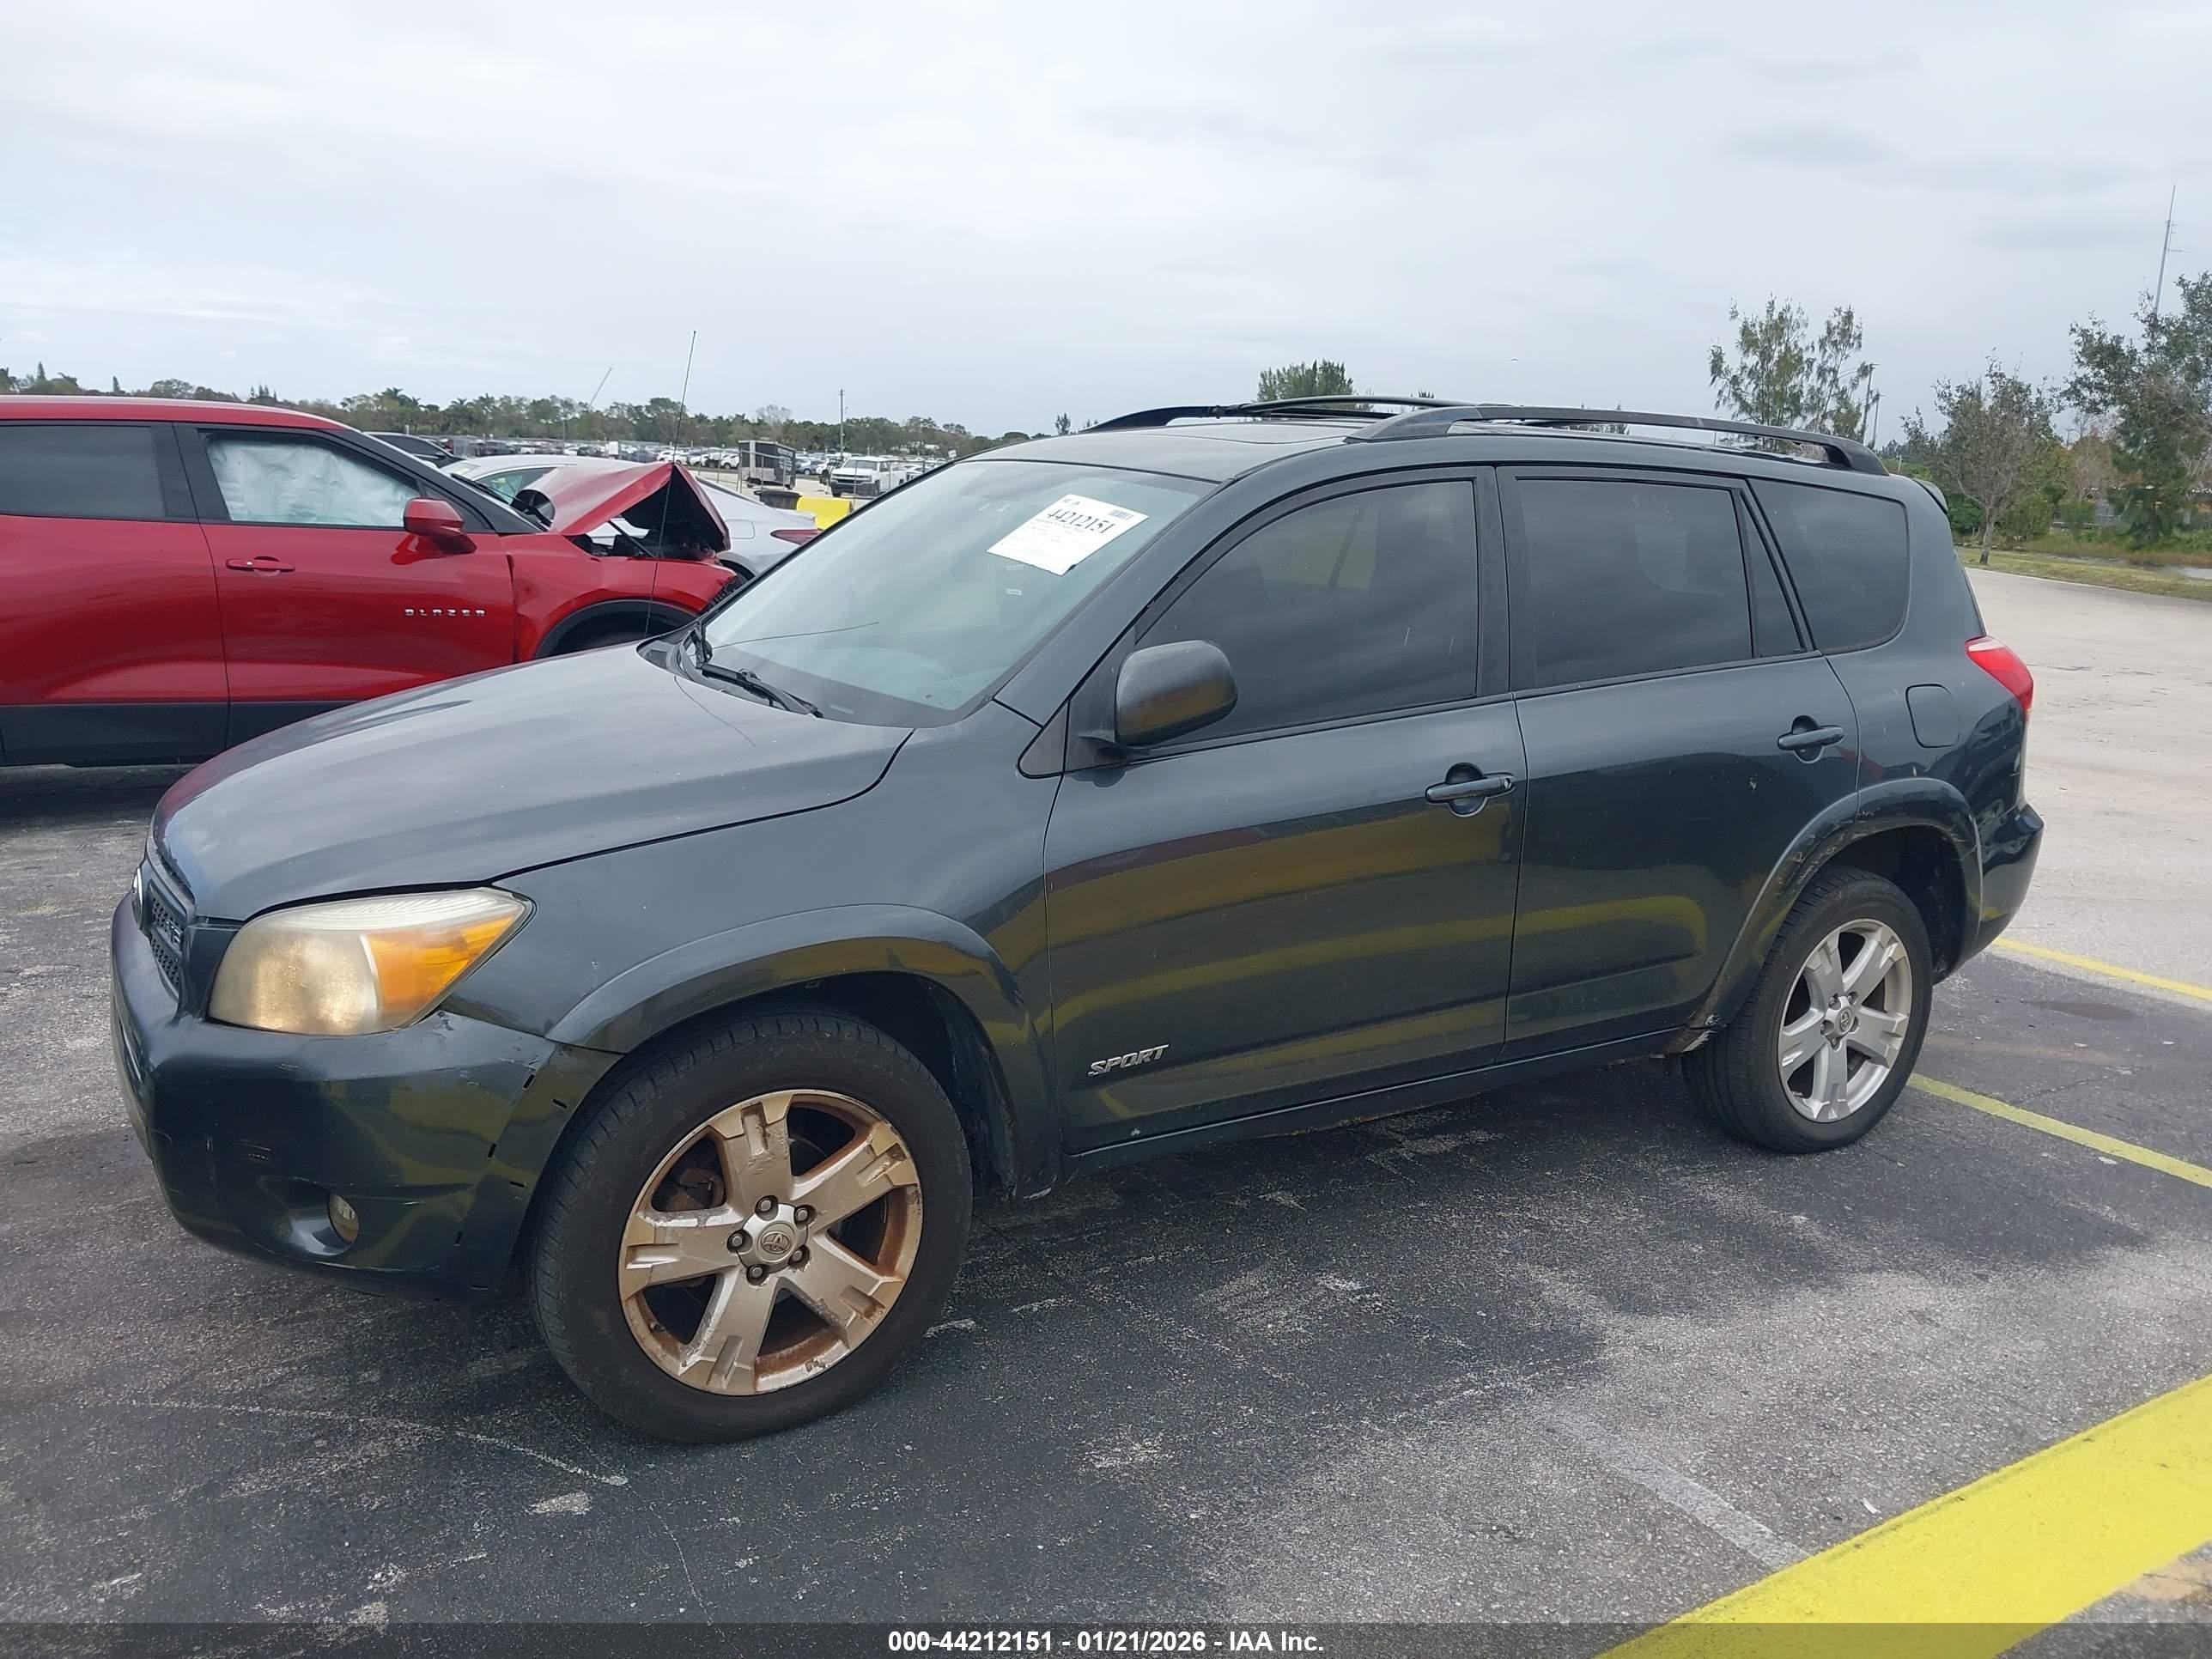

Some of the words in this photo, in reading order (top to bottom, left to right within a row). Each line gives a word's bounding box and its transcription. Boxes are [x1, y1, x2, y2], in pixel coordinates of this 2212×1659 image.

[1047, 508, 1116, 534] 44212151
[404, 608, 486, 617] BLAZER
[1087, 1043, 1170, 1076] SPORT
